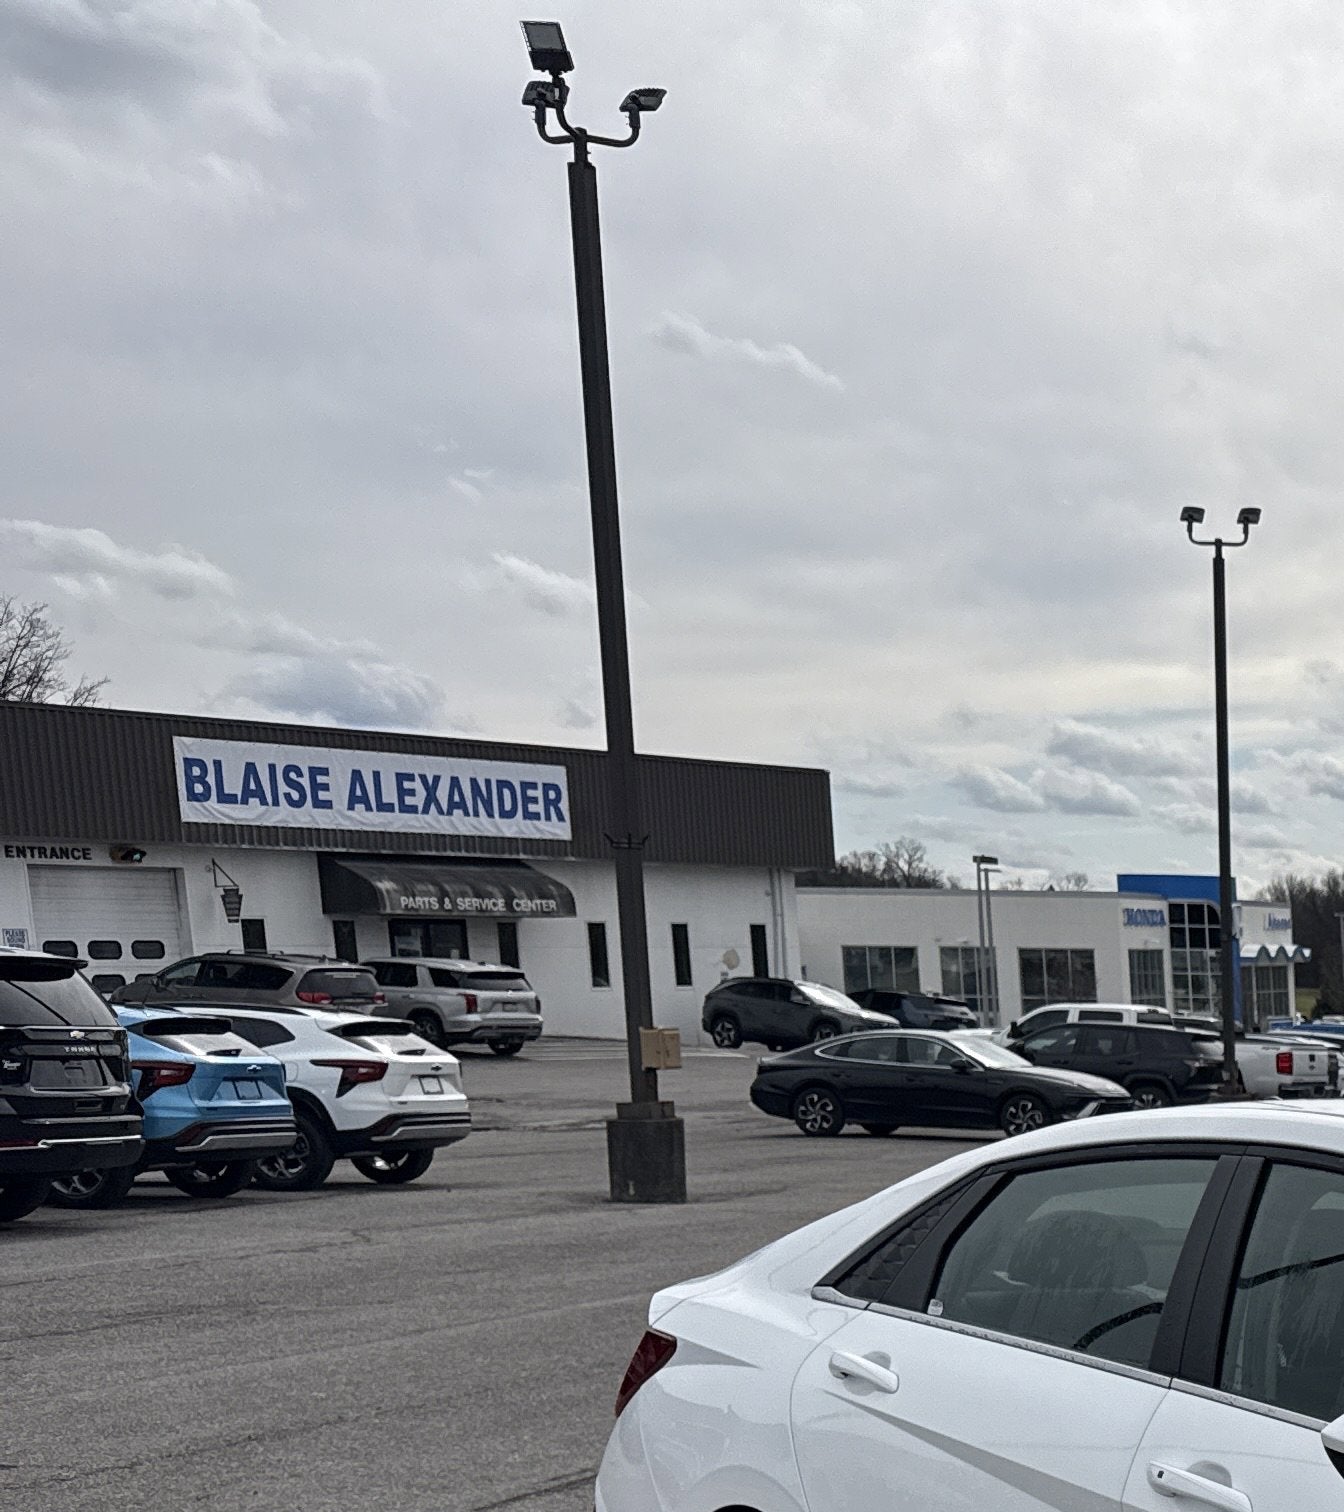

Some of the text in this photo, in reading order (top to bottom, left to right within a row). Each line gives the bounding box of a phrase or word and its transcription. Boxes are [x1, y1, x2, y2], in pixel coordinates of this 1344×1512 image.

[183, 757, 566, 823] BLAISE ALEXANDER
[4, 844, 93, 861] ENTRANCE
[400, 896, 557, 912] PARTS & SERVICE CENTER
